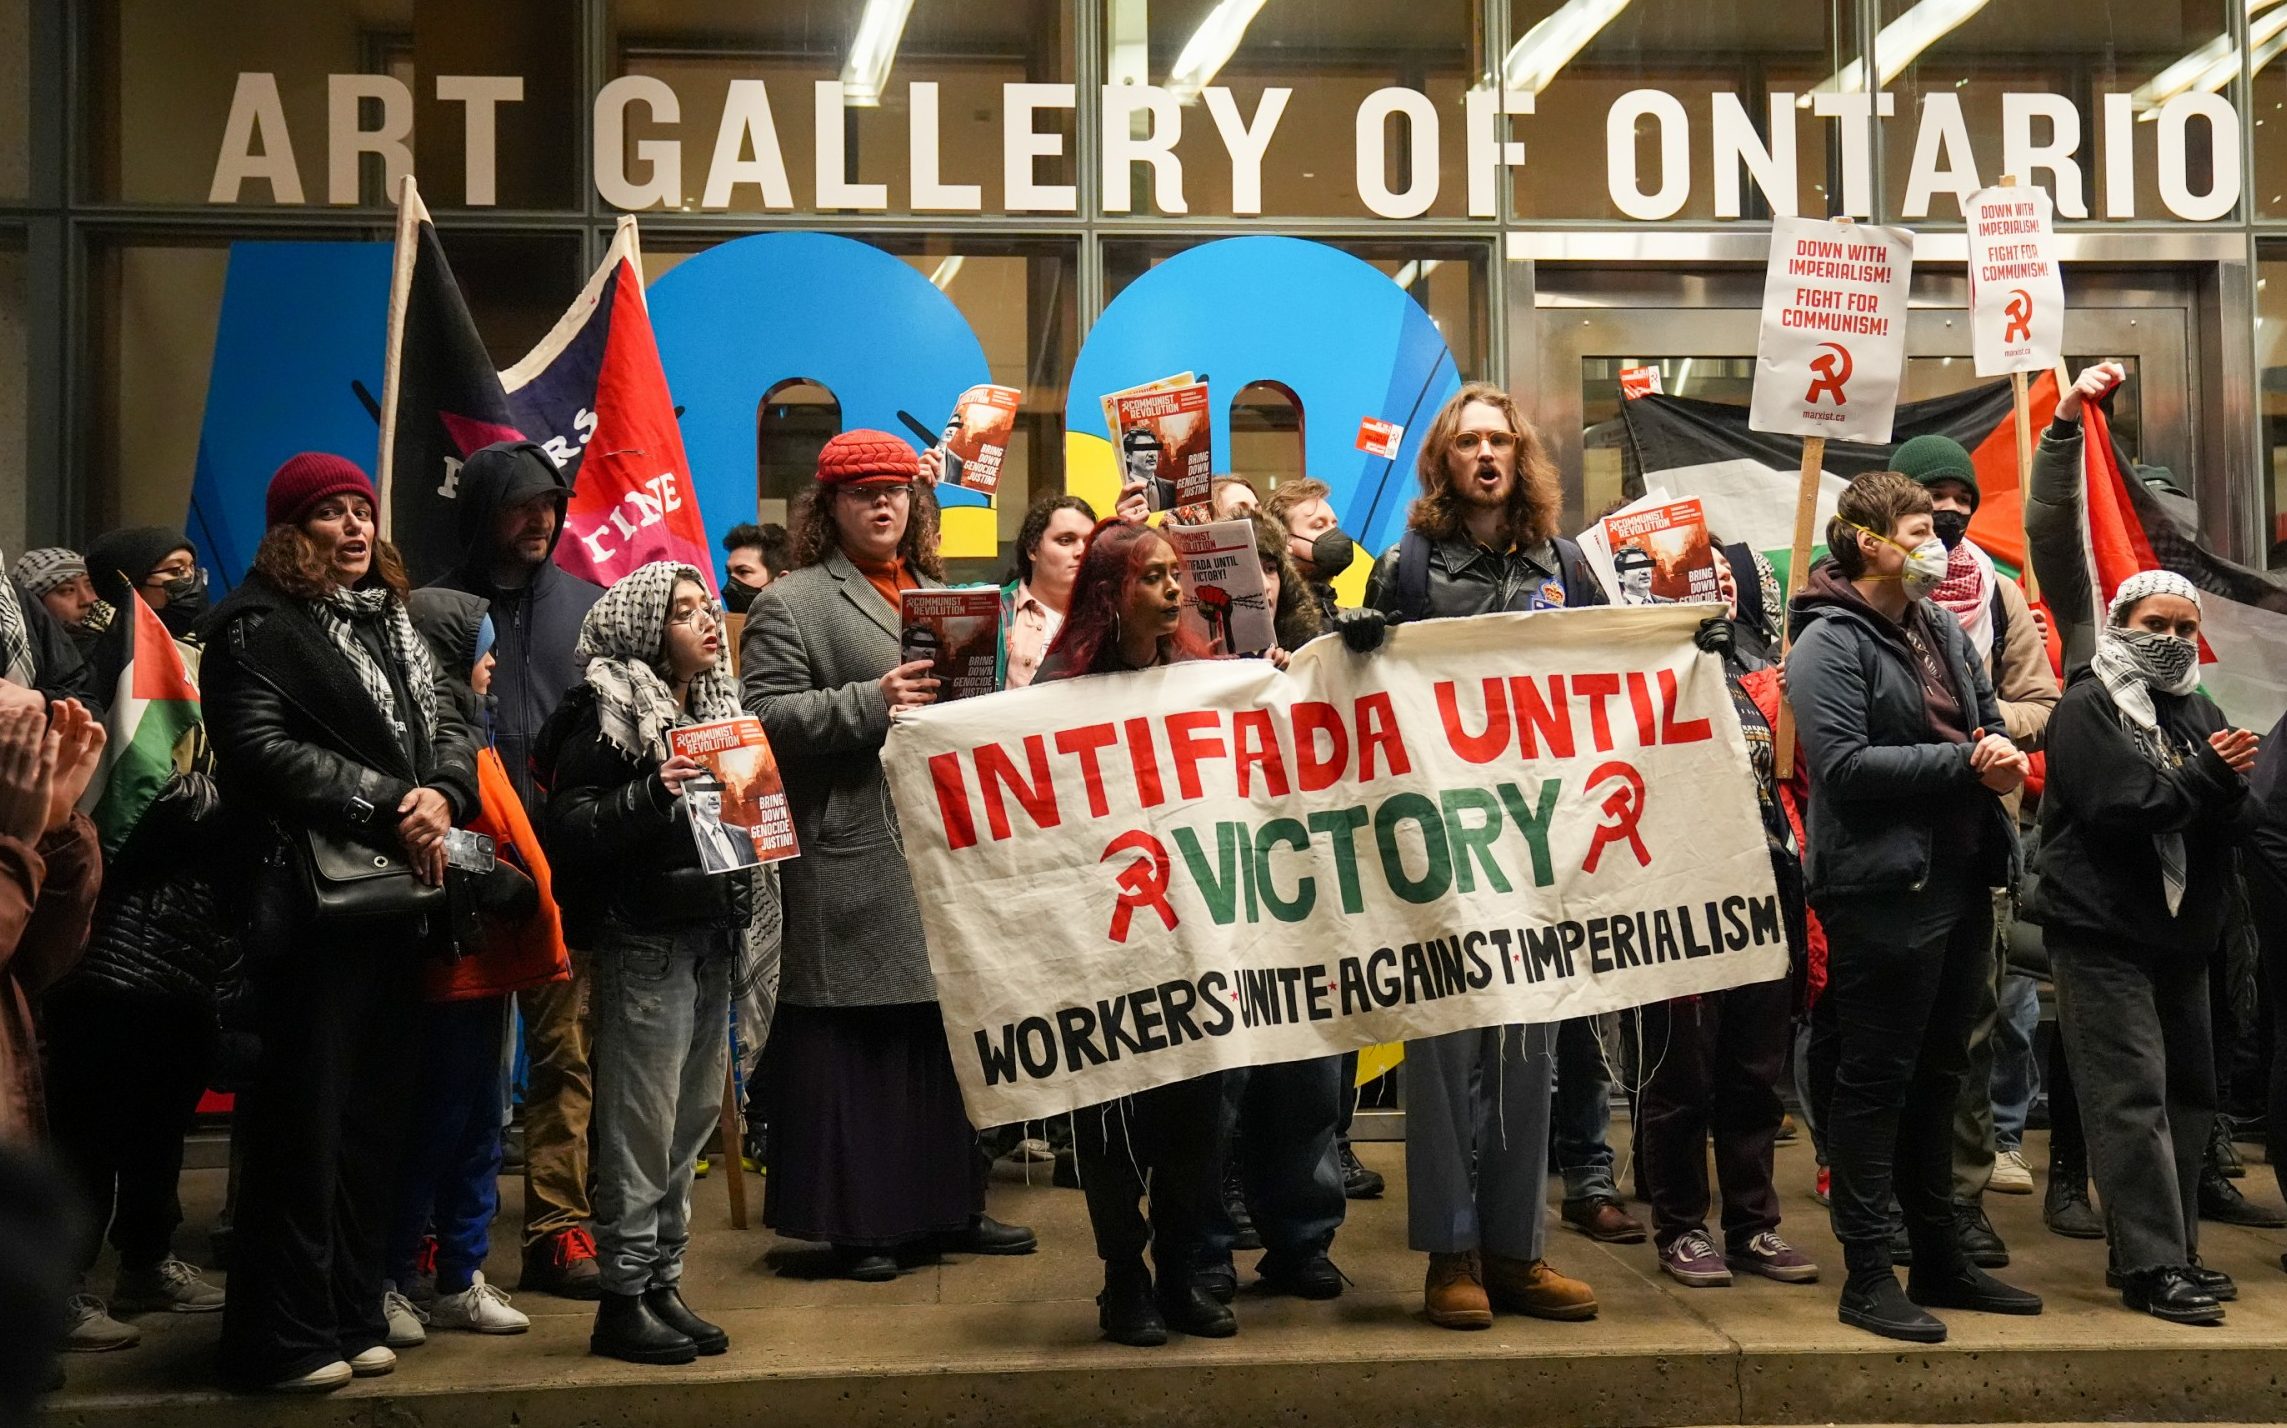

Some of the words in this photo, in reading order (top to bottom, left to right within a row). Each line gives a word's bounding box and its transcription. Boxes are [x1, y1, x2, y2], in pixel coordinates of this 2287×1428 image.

[208, 72, 524, 206] ART
[593, 75, 1293, 214] GALLERY
[1355, 87, 1535, 219] OF
[1606, 88, 2240, 221] ONTARIO
[1981, 204, 2012, 219] DOWN
[2015, 203, 2034, 216] WITH
[1979, 219, 2040, 236] IMPERIALISM!
[1796, 239, 1843, 259] DOWN
[1848, 244, 1887, 263] WITH
[1988, 245, 2019, 262] FIGHT
[2020, 244, 2038, 259] FOR
[1788, 258, 1891, 284] IMPERIALISM!
[1982, 262, 2049, 282] COMMUNISM!
[1796, 288, 1843, 310] FIGHT
[1847, 294, 1879, 313] FOR
[1782, 308, 1889, 336] COMMUNISM!
[2004, 347, 2031, 357] marxist.ca
[1129, 394, 1174, 410] COMMUNIST
[1130, 403, 1179, 419] REVOLUTION
[1802, 410, 1846, 422] marxist.ca
[980, 443, 1004, 457] BRING
[1188, 451, 1209, 466] BRING
[978, 453, 1001, 466] DOWN
[963, 460, 999, 477] GENOCIDE
[1188, 461, 1209, 476] DOWN
[967, 471, 997, 486] JUSTIN!
[1176, 472, 1209, 489] GENOCIDE
[1182, 482, 1209, 498] JUSTIN!
[1616, 509, 1665, 530] COMMUNIST
[1619, 518, 1671, 538] REVOLUTION
[1214, 555, 1239, 568] UNTIL
[1192, 569, 1227, 583] VICTORY!
[1688, 567, 1713, 583] BRING
[1691, 579, 1716, 594] DOWN
[914, 596, 962, 607] COMMUNIST
[914, 605, 965, 615] REVOLUTION
[968, 655, 994, 666] BRING
[967, 665, 994, 676] DOWN
[953, 676, 993, 688] GENOCIDE
[685, 724, 735, 744] COMMUNIST
[687, 735, 741, 756] REVOLUTION
[928, 691, 1412, 851] INTIFADA
[1434, 668, 1713, 764] UNTIL
[759, 793, 784, 810] BRING
[761, 806, 787, 823] DOWN
[751, 819, 790, 839] GENOCIDE
[761, 833, 793, 851] JUSTIN!
[1171, 778, 1562, 926] VICTORY
[974, 970, 1234, 1086] WORKERS
[1234, 964, 1333, 1028] UNITE
[1339, 929, 1515, 1017] AGAINST
[1518, 895, 1780, 984] IMPERIALISM
